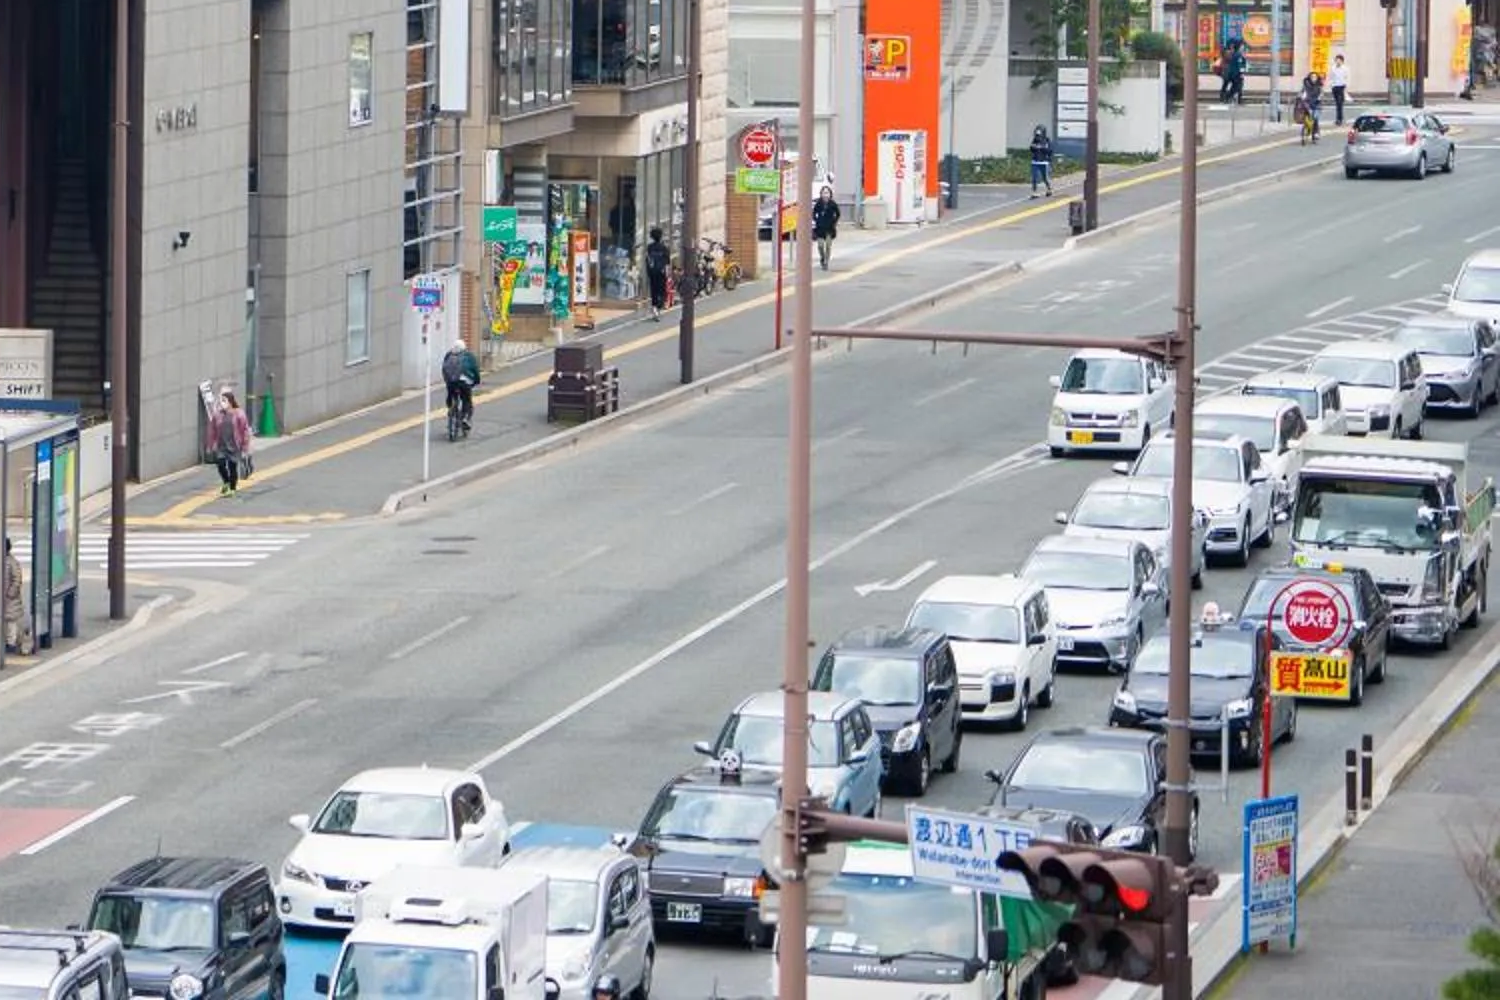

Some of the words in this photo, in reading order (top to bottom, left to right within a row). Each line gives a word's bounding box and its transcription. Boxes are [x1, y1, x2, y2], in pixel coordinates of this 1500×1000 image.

[6, 382, 42, 395] SHIFT
[1289, 605, 1334, 629] 消火栓
[1276, 658, 1301, 693] 質
